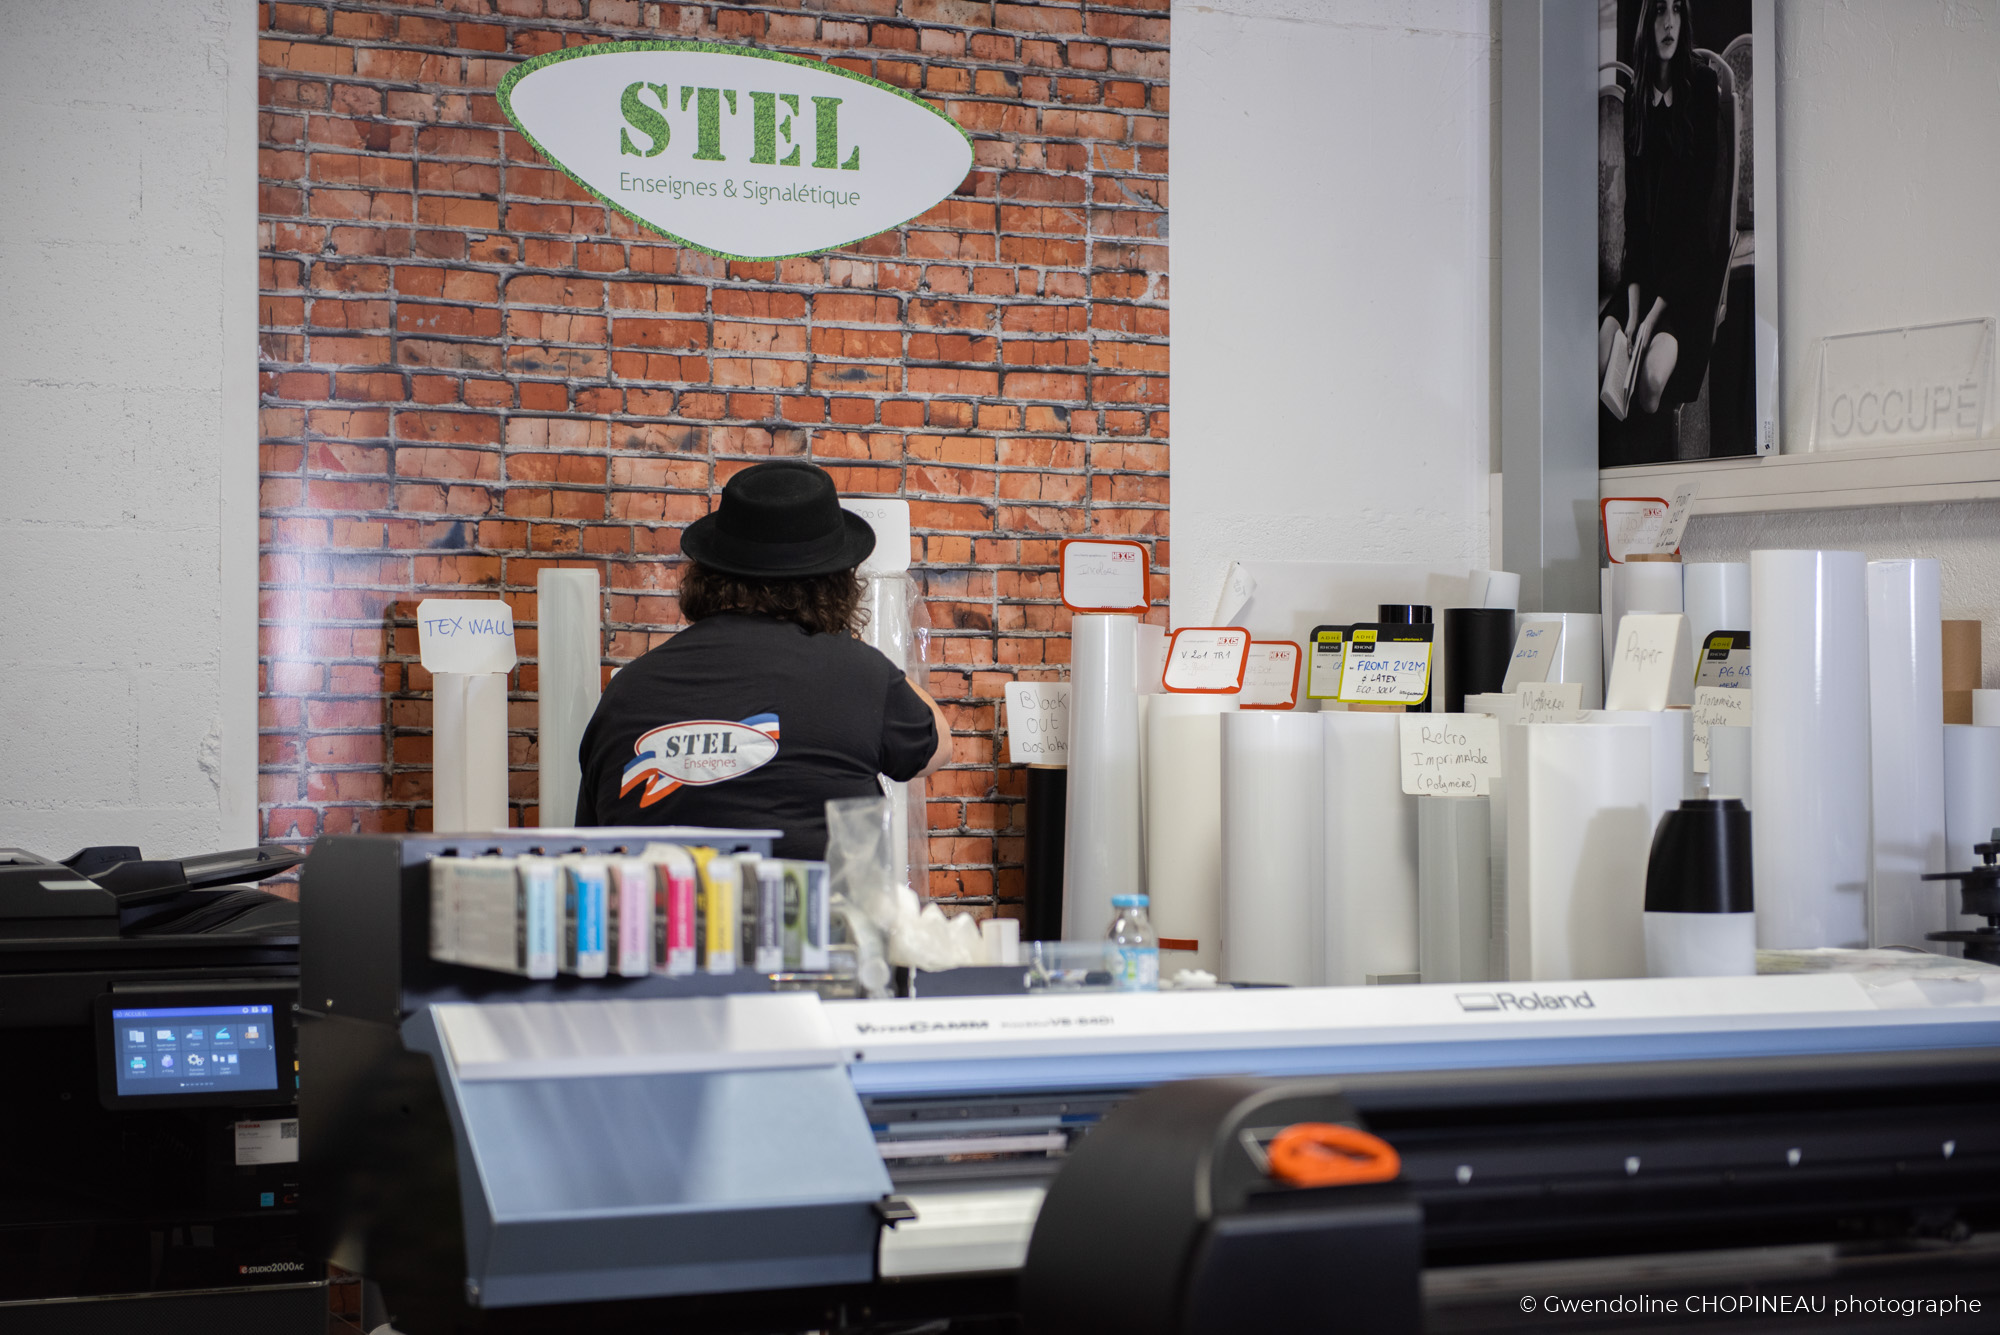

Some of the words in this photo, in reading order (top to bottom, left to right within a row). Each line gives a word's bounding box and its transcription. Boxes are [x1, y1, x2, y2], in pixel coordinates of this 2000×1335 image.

[620, 81, 860, 170] STEL
[620, 172, 717, 199] Enseignes
[723, 179, 738, 198] &
[743, 180, 861, 208] Signalétique
[1112, 552, 1135, 562] HEXIS
[424, 616, 462, 637] TEX
[468, 618, 513, 636] WALL
[1357, 660, 1389, 672] FRONT
[1370, 673, 1398, 683] LATEX
[666, 732, 737, 758] STEL
[1421, 724, 1467, 745] Retro
[684, 758, 737, 771] Enseignes
[1496, 990, 1596, 1011] Roland
